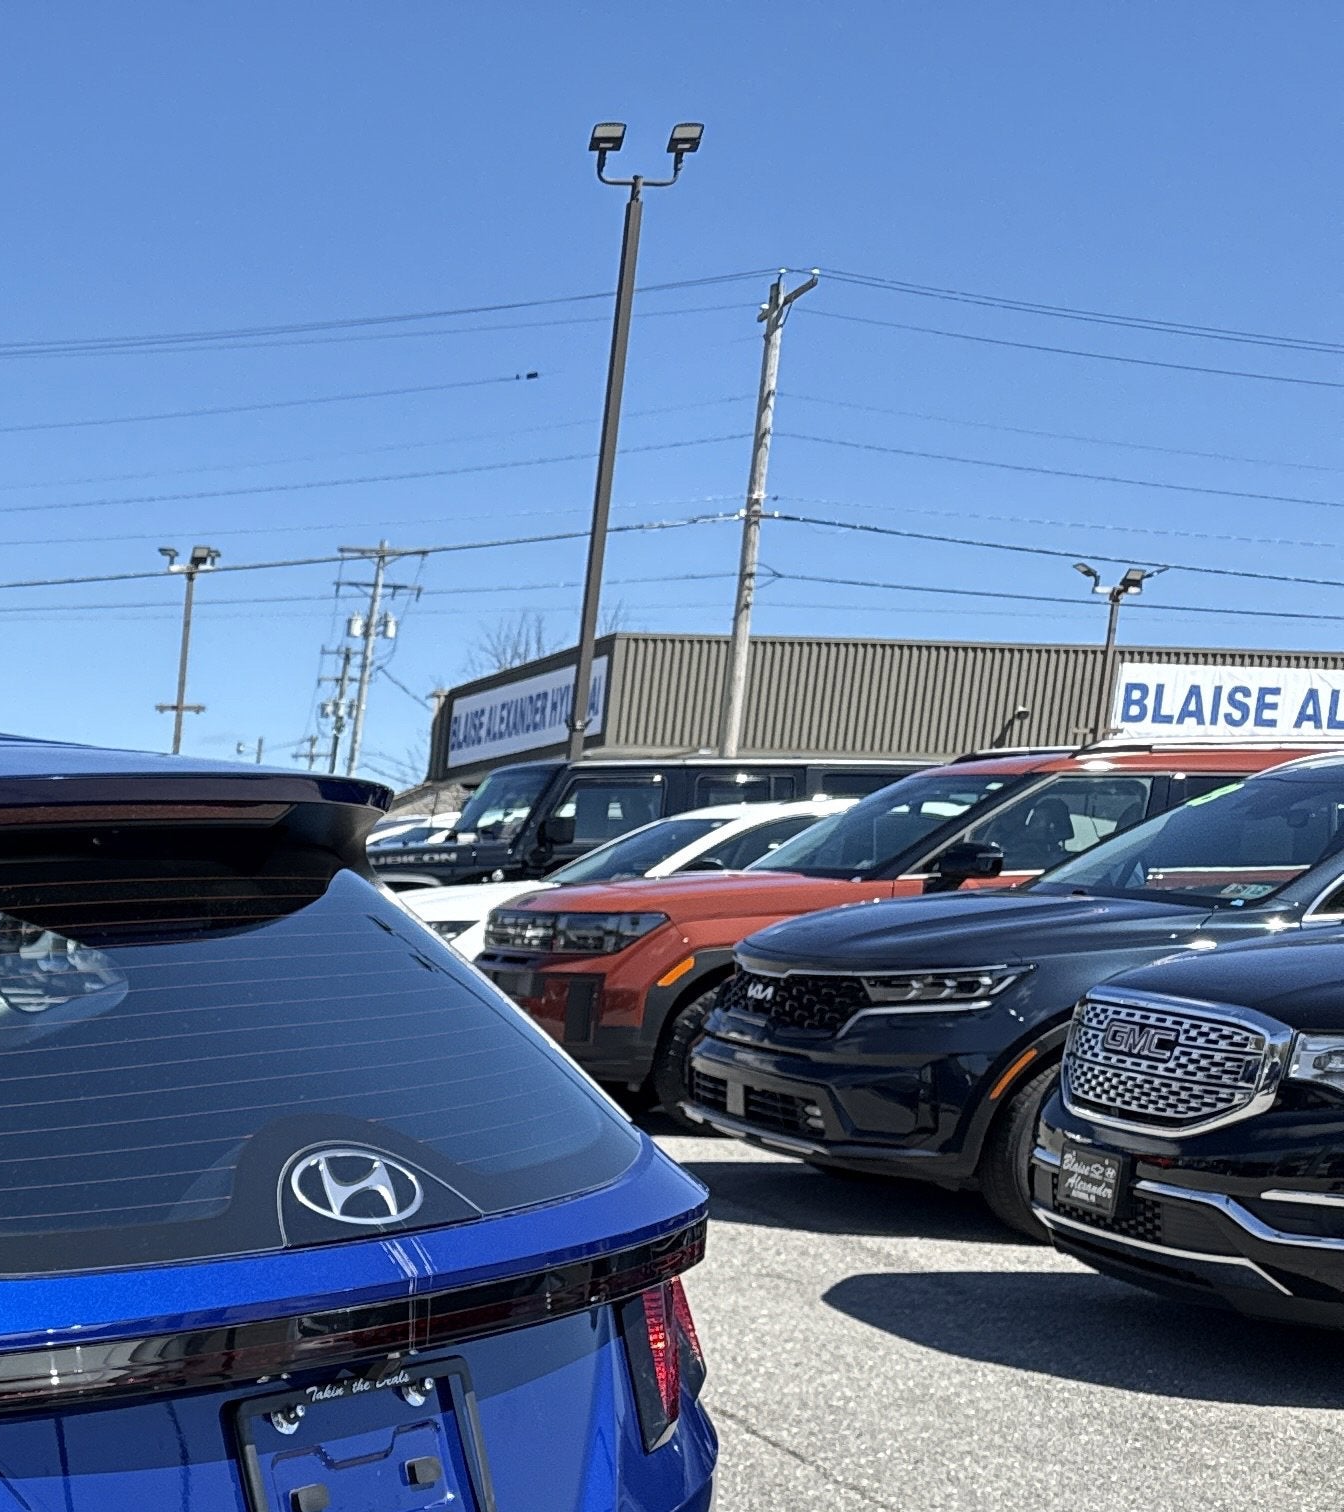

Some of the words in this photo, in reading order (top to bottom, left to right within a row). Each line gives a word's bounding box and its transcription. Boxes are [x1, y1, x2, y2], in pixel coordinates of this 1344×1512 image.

[450, 708, 485, 751] BLAISE
[485, 689, 548, 743] ALEXANDER
[1121, 682, 1281, 728] BLAISE
[368, 852, 458, 866] UBICON
[1104, 1020, 1178, 1060] GMC
[351, 1377, 371, 1393] the
